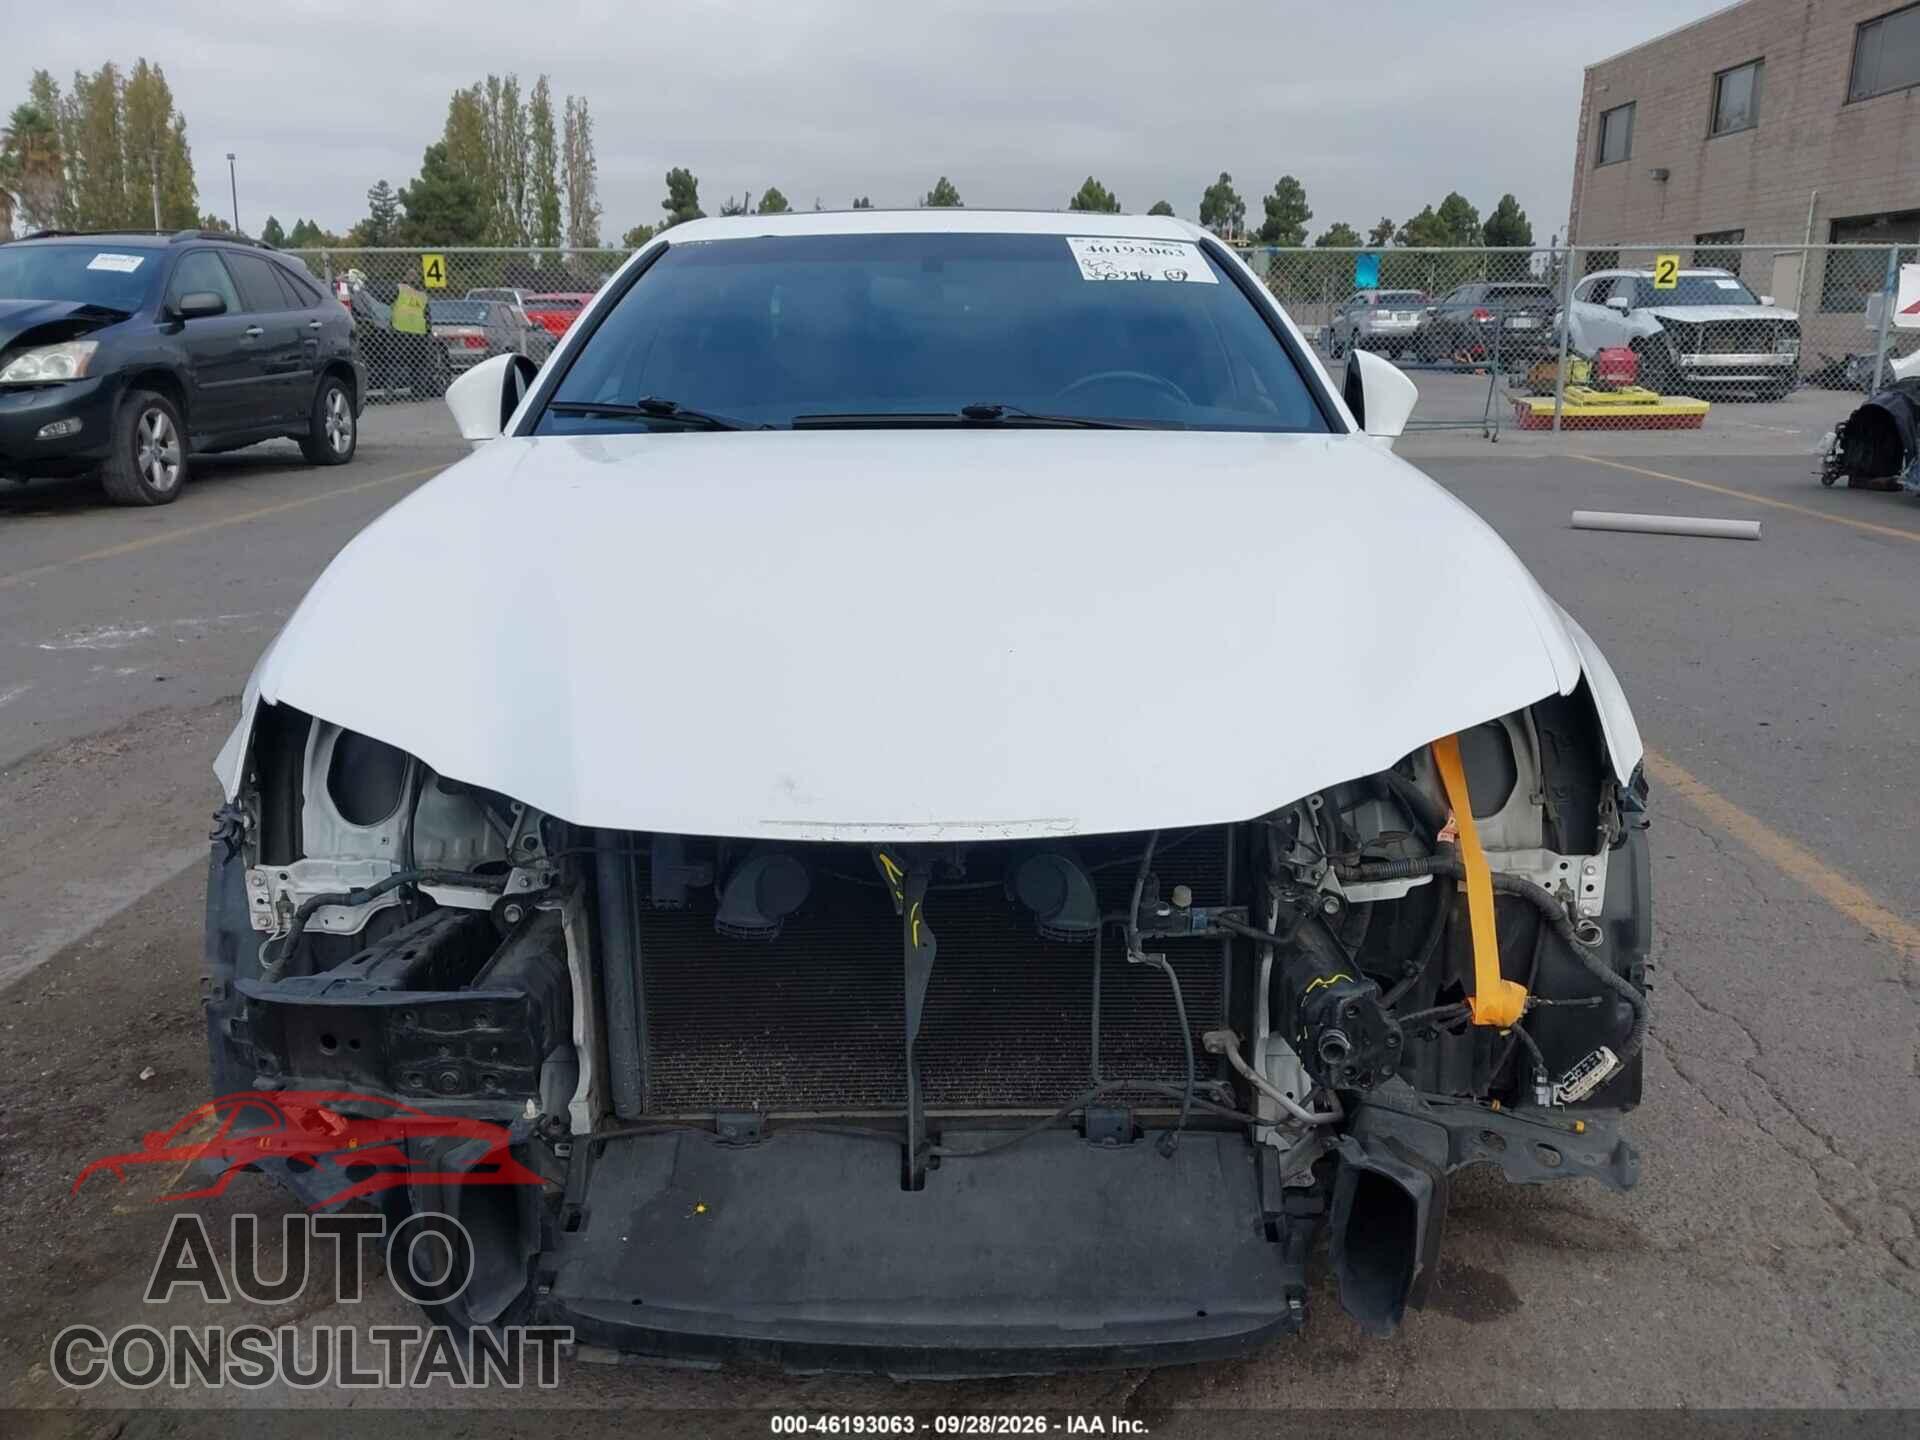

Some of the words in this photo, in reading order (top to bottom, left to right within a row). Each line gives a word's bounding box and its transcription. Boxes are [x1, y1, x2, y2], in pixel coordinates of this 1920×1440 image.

[1086, 245, 1186, 257] 46193063
[427, 259, 442, 282] 4
[1658, 260, 1675, 283] 2
